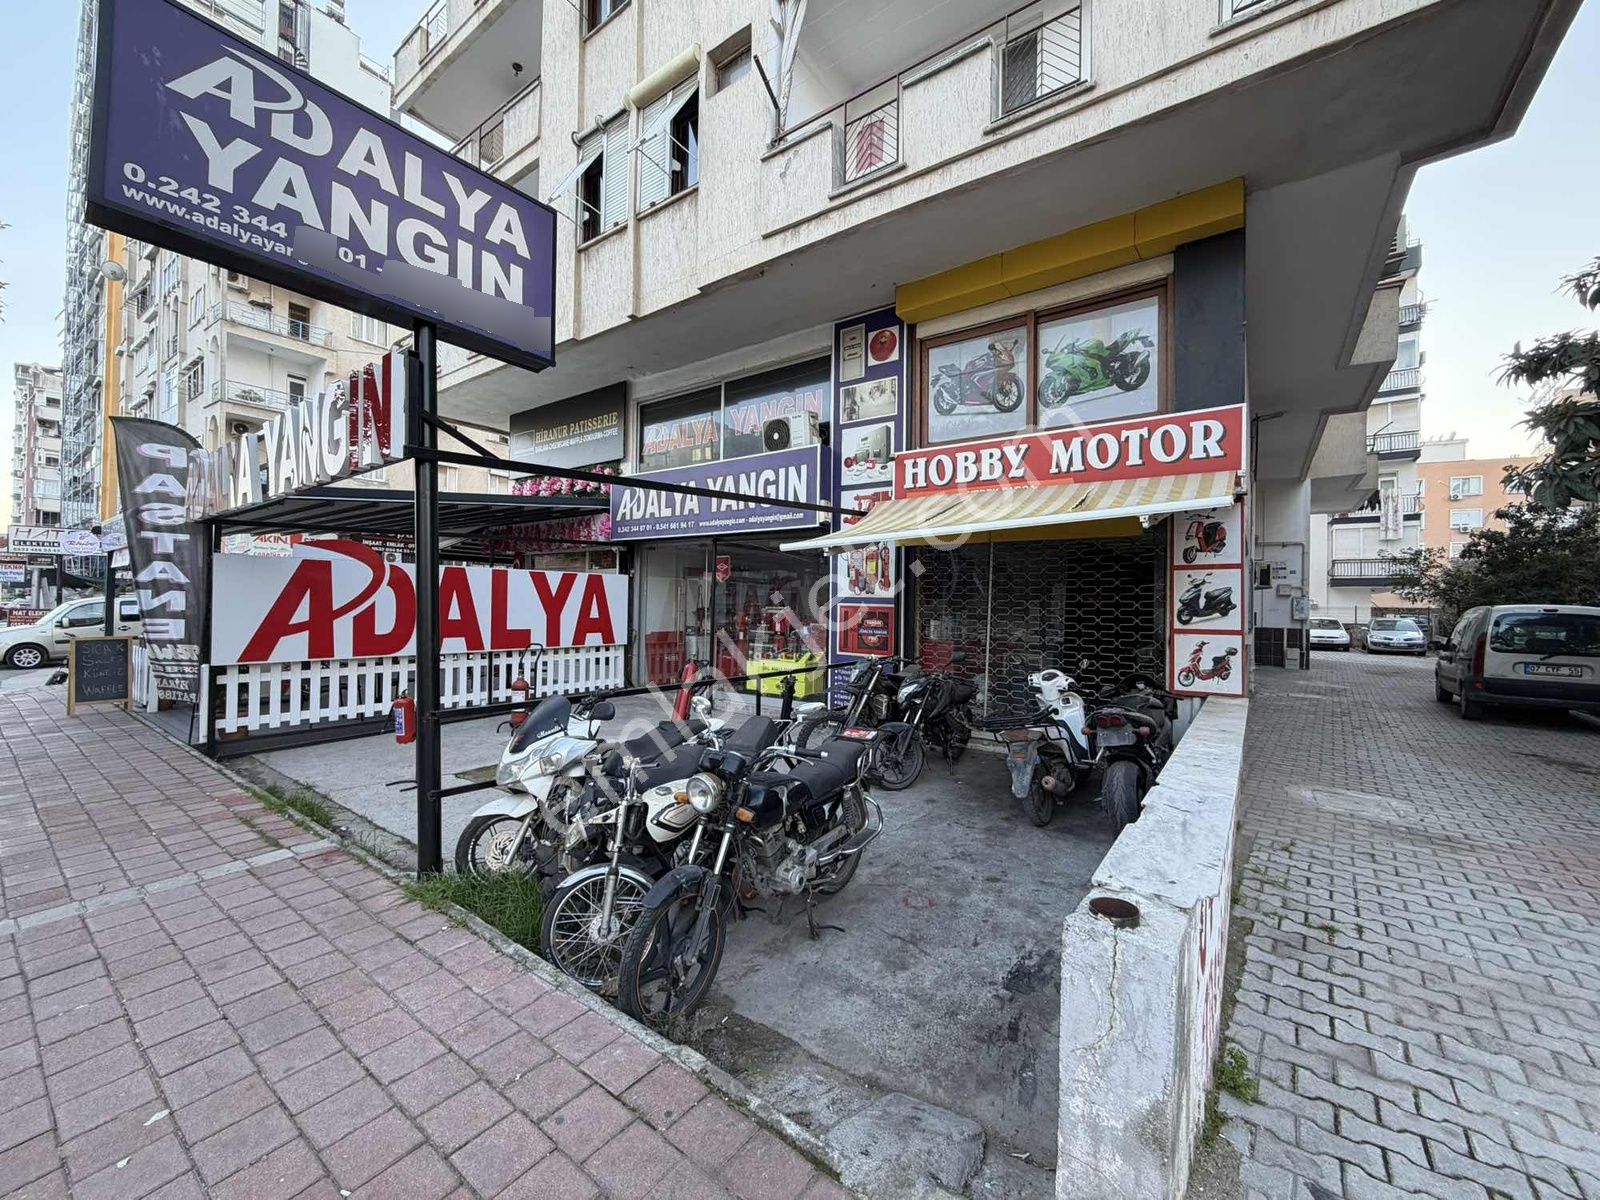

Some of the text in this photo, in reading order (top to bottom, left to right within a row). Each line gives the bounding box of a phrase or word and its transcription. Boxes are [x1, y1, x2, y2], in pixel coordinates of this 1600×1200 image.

[165, 44, 532, 260] ADALYA
[179, 110, 524, 304] YANGIN
[232, 205, 288, 239] 344
[338, 246, 366, 270] 01
[263, 352, 398, 499] YANGIN
[569, 411, 619, 436] PATISSERIE
[903, 418, 1226, 489] HOBBY MOTOR
[616, 464, 808, 522] ADALYA YANGIN
[237, 539, 616, 664] ADALYA
